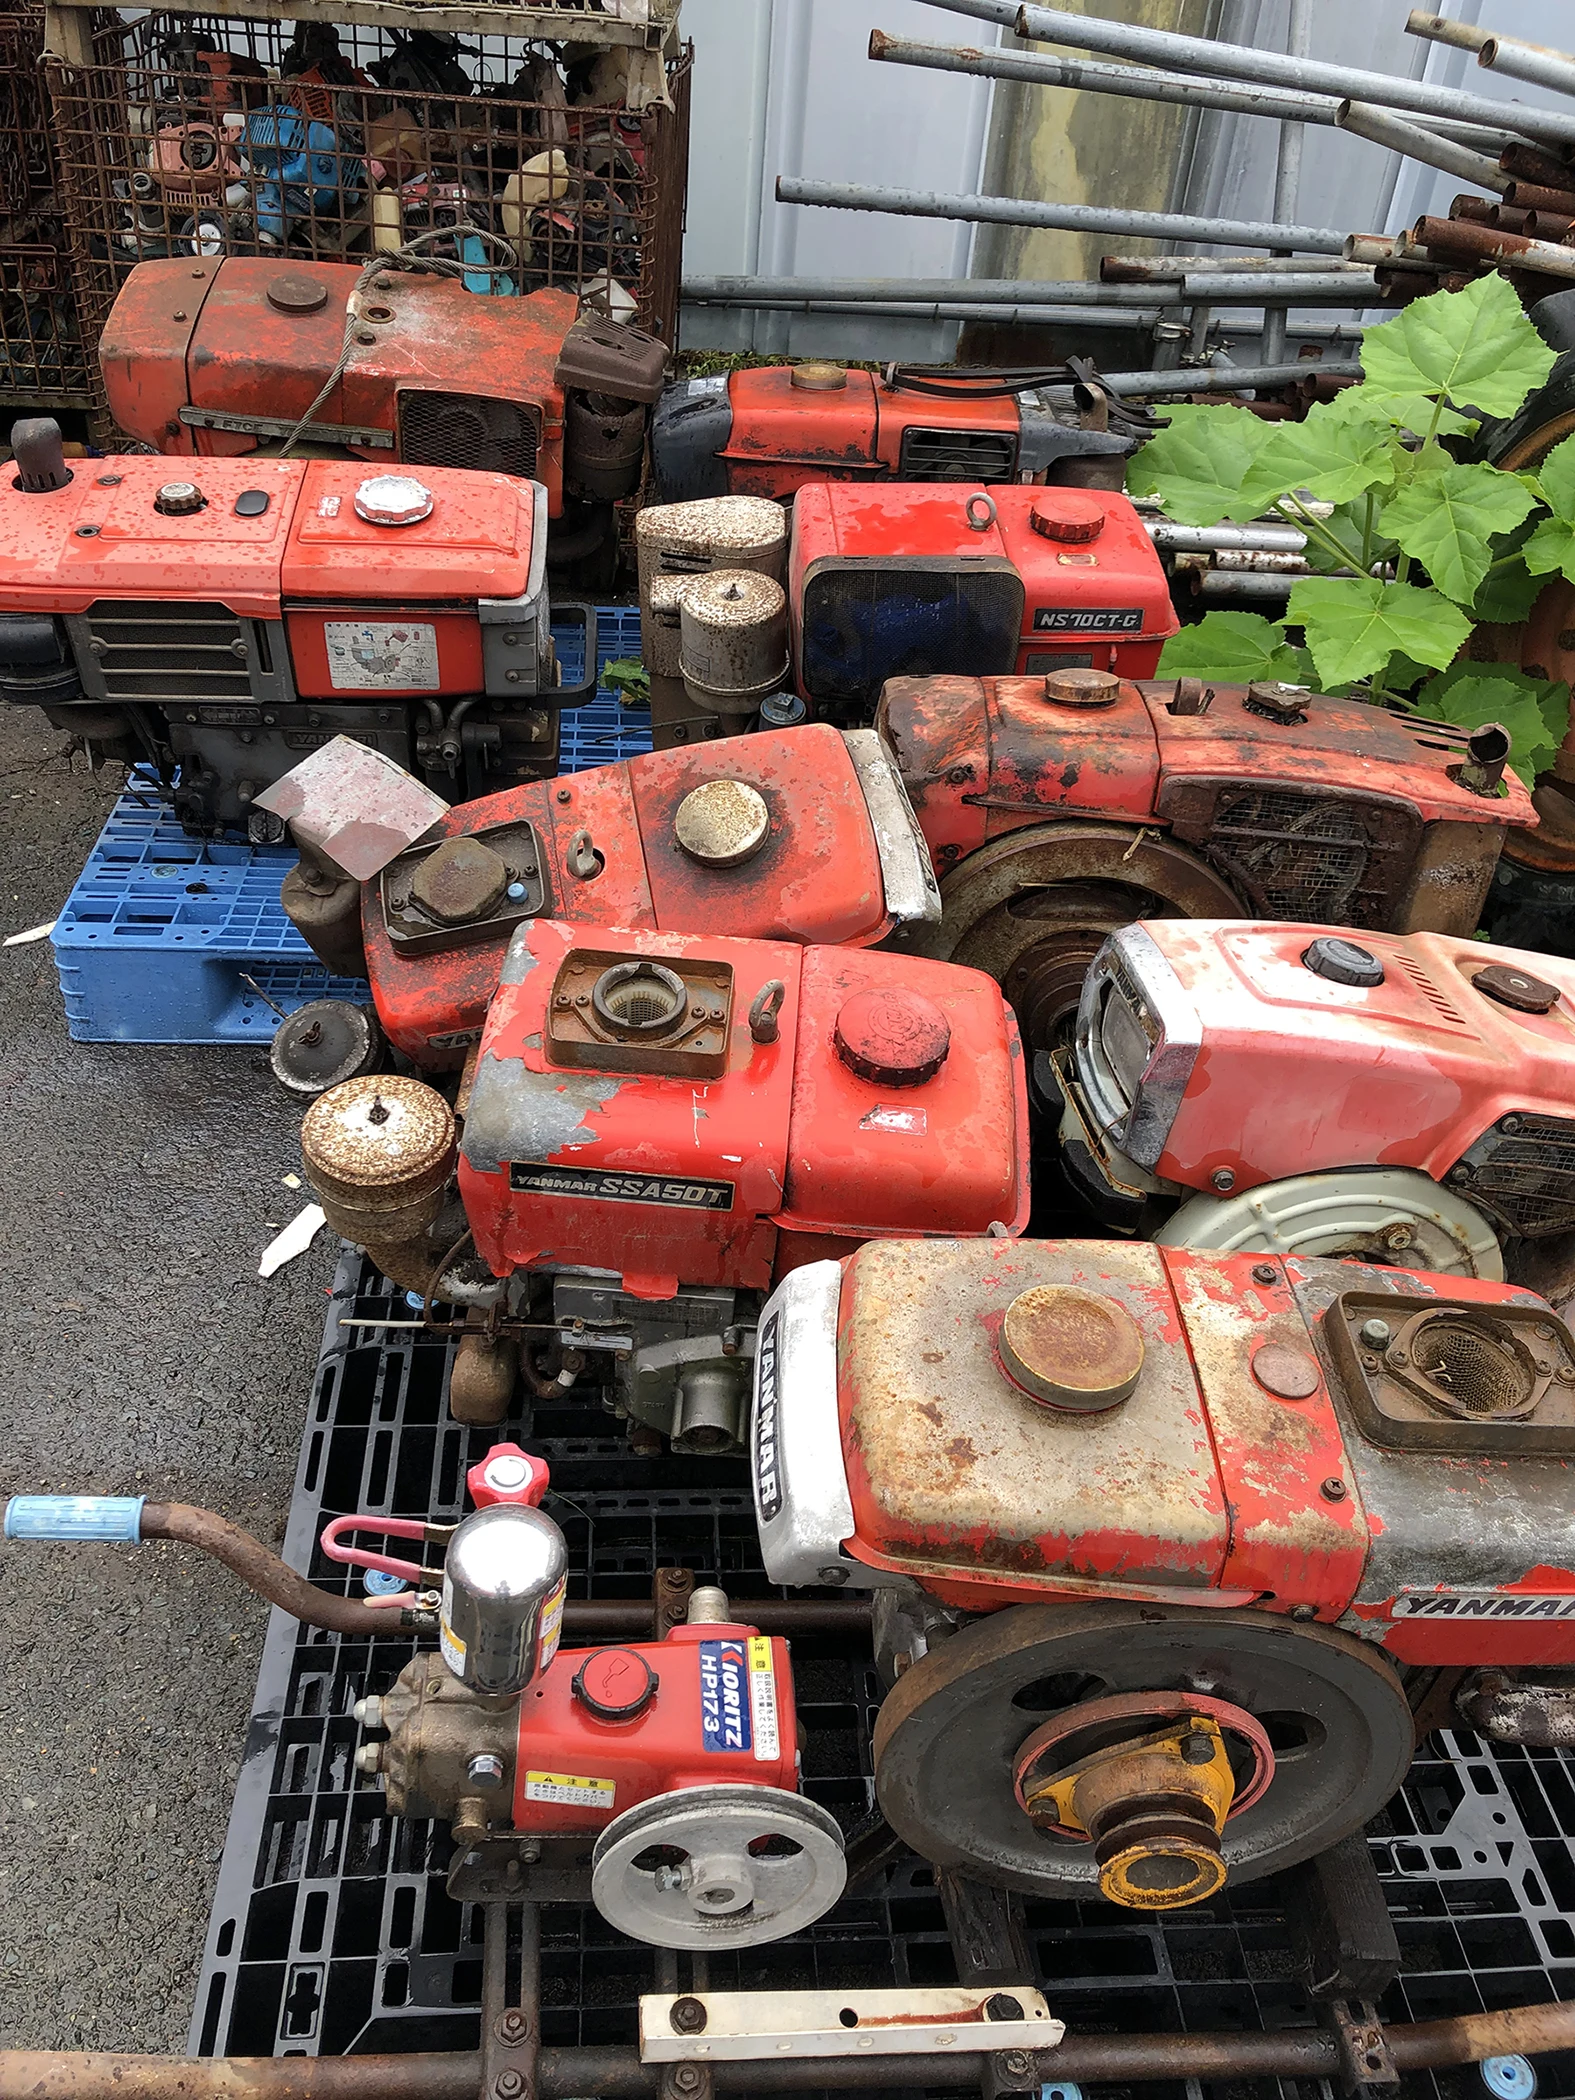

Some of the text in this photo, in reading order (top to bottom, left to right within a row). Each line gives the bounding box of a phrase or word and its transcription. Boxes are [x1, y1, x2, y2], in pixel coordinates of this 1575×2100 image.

[1040, 613, 1138, 627] NS70CT-G
[296, 734, 368, 747] YANR
[517, 1174, 729, 1204] YANMAR SSA50T
[758, 1325, 778, 1505] YANMAR
[701, 1654, 720, 1733] HP173
[720, 1641, 744, 1748] KIORITZ
